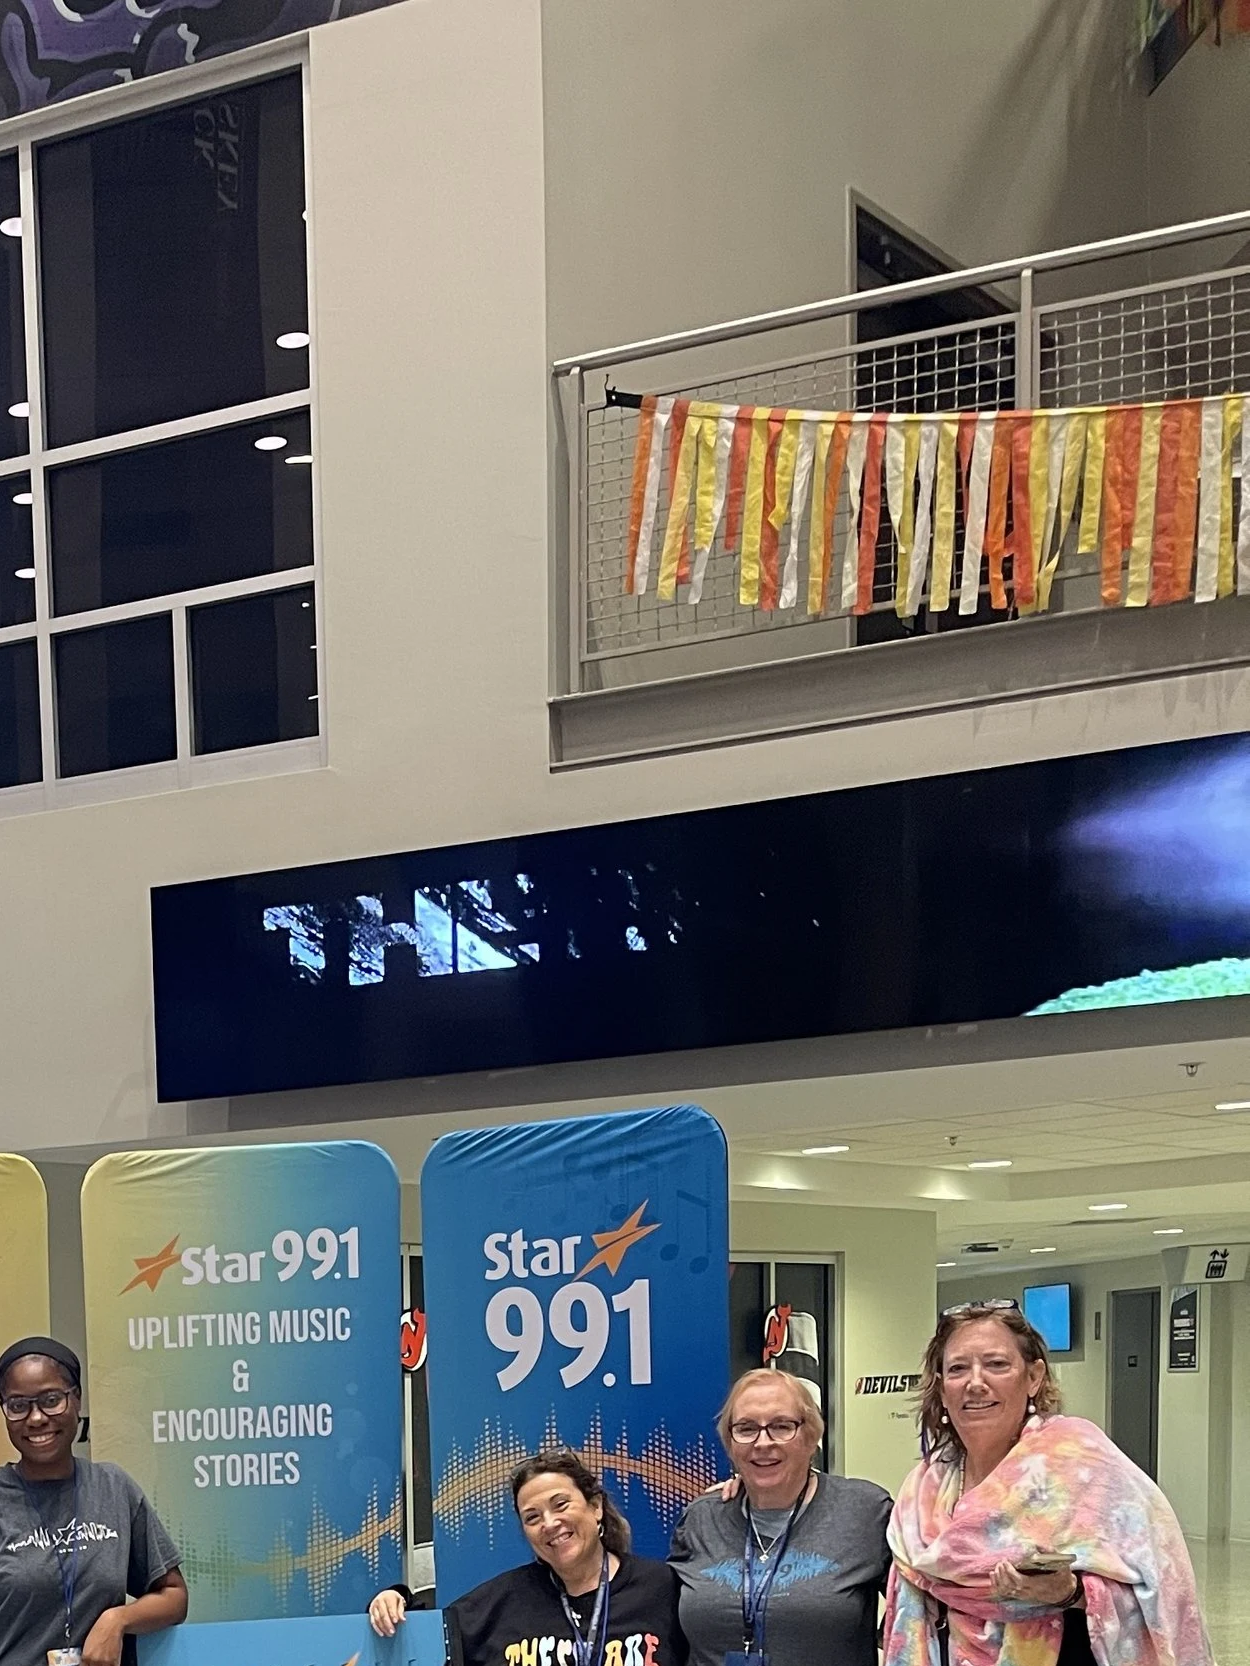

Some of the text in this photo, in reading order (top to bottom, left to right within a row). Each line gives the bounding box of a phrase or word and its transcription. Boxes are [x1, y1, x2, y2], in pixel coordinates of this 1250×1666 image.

[181, 1227, 359, 1285] Star 99.1
[483, 1228, 582, 1281] Star
[128, 1307, 351, 1351] UPLIFTING MUSIC
[485, 1278, 651, 1392] 99.1
[232, 1359, 250, 1392] &
[863, 1375, 908, 1395] DEVILS
[152, 1402, 333, 1443] ENCOURAGING
[194, 1451, 300, 1488] STORIES
